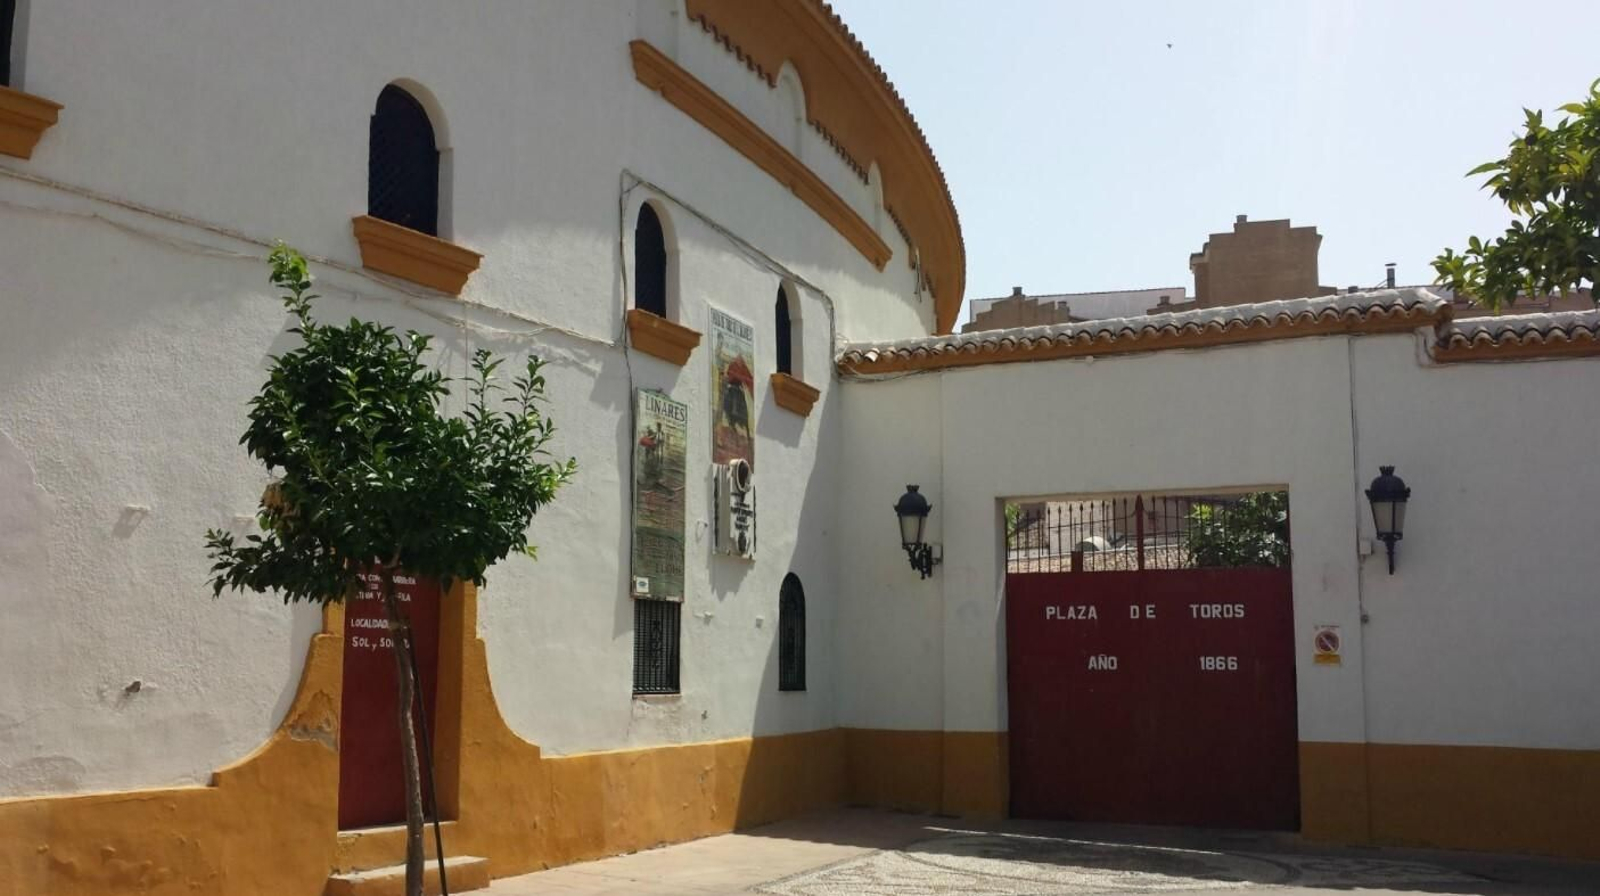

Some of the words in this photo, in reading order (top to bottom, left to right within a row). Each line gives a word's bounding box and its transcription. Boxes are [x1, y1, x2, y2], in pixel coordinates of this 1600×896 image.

[645, 395, 685, 422] LINARES
[1045, 605, 1098, 620] PLAZA
[1130, 604, 1156, 619] DE
[1189, 603, 1245, 619] TOROS
[352, 636, 370, 647] SOL
[1088, 654, 1118, 670] AÑO
[1200, 656, 1238, 671] 1866
